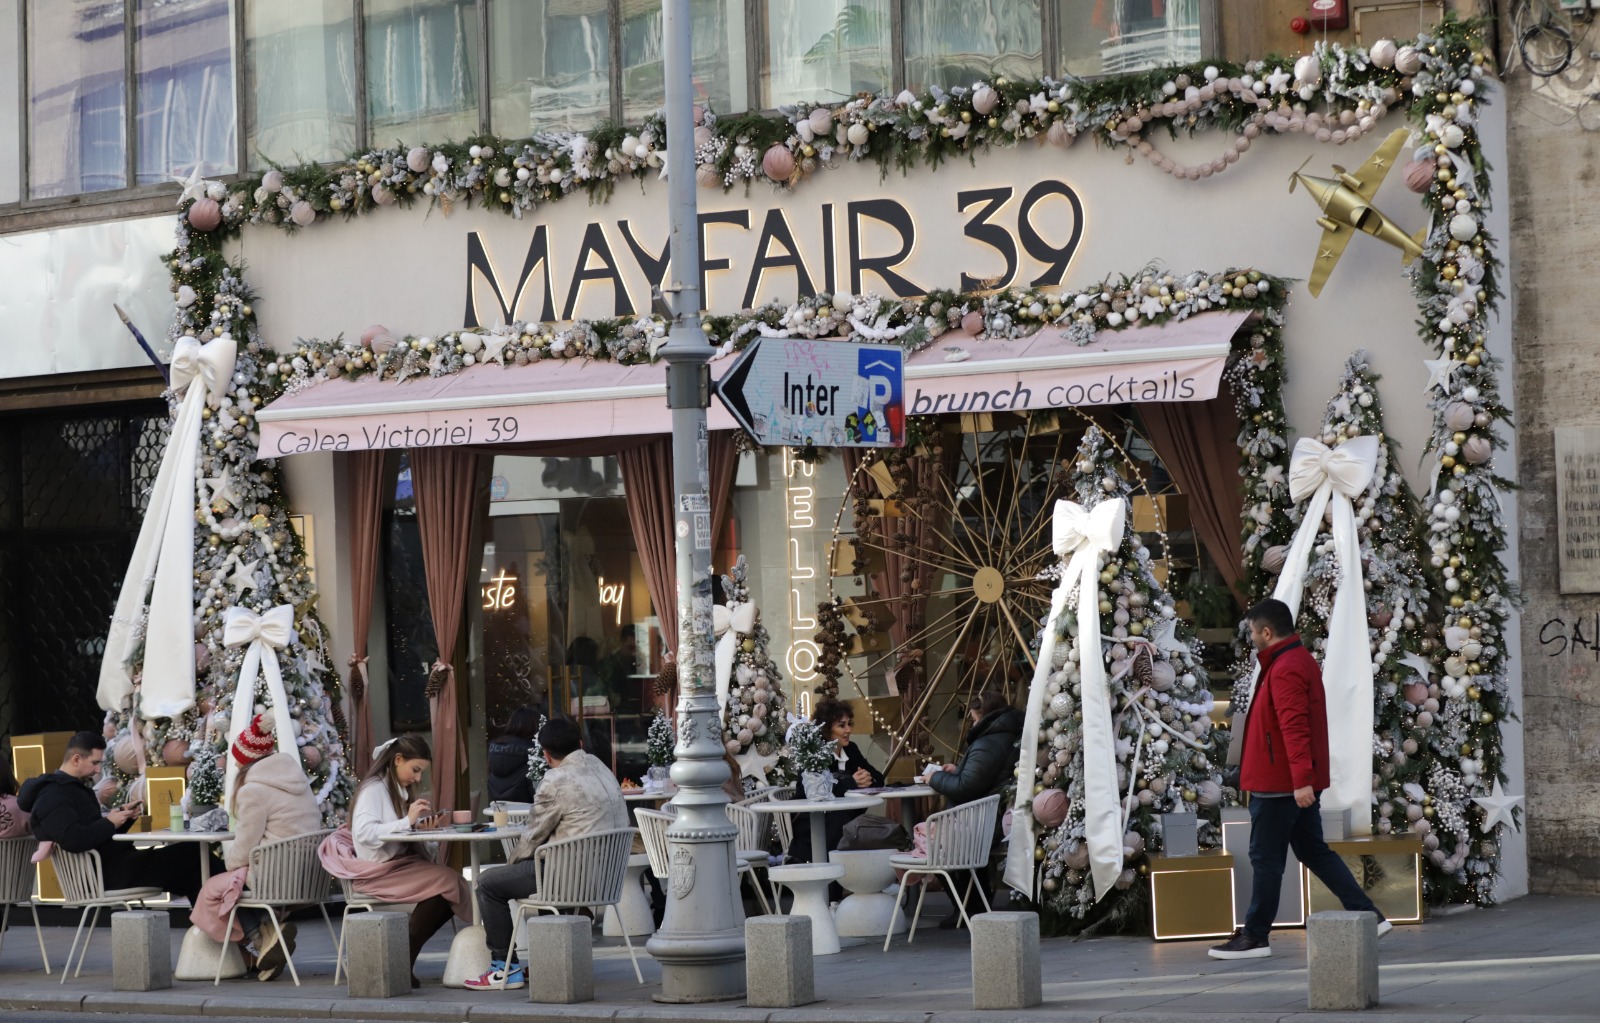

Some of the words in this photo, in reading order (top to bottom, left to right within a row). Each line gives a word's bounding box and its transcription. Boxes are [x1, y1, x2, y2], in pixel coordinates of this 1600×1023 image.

[463, 198, 929, 329] MAYFAIR
[957, 179, 1086, 294] 39
[784, 371, 839, 416] Inter
[910, 381, 1031, 415] brunch
[1046, 370, 1195, 407] cocktails
[277, 429, 349, 455] Calea
[362, 419, 473, 449] Victoriei
[485, 416, 519, 443] 39
[481, 569, 517, 610] ste
